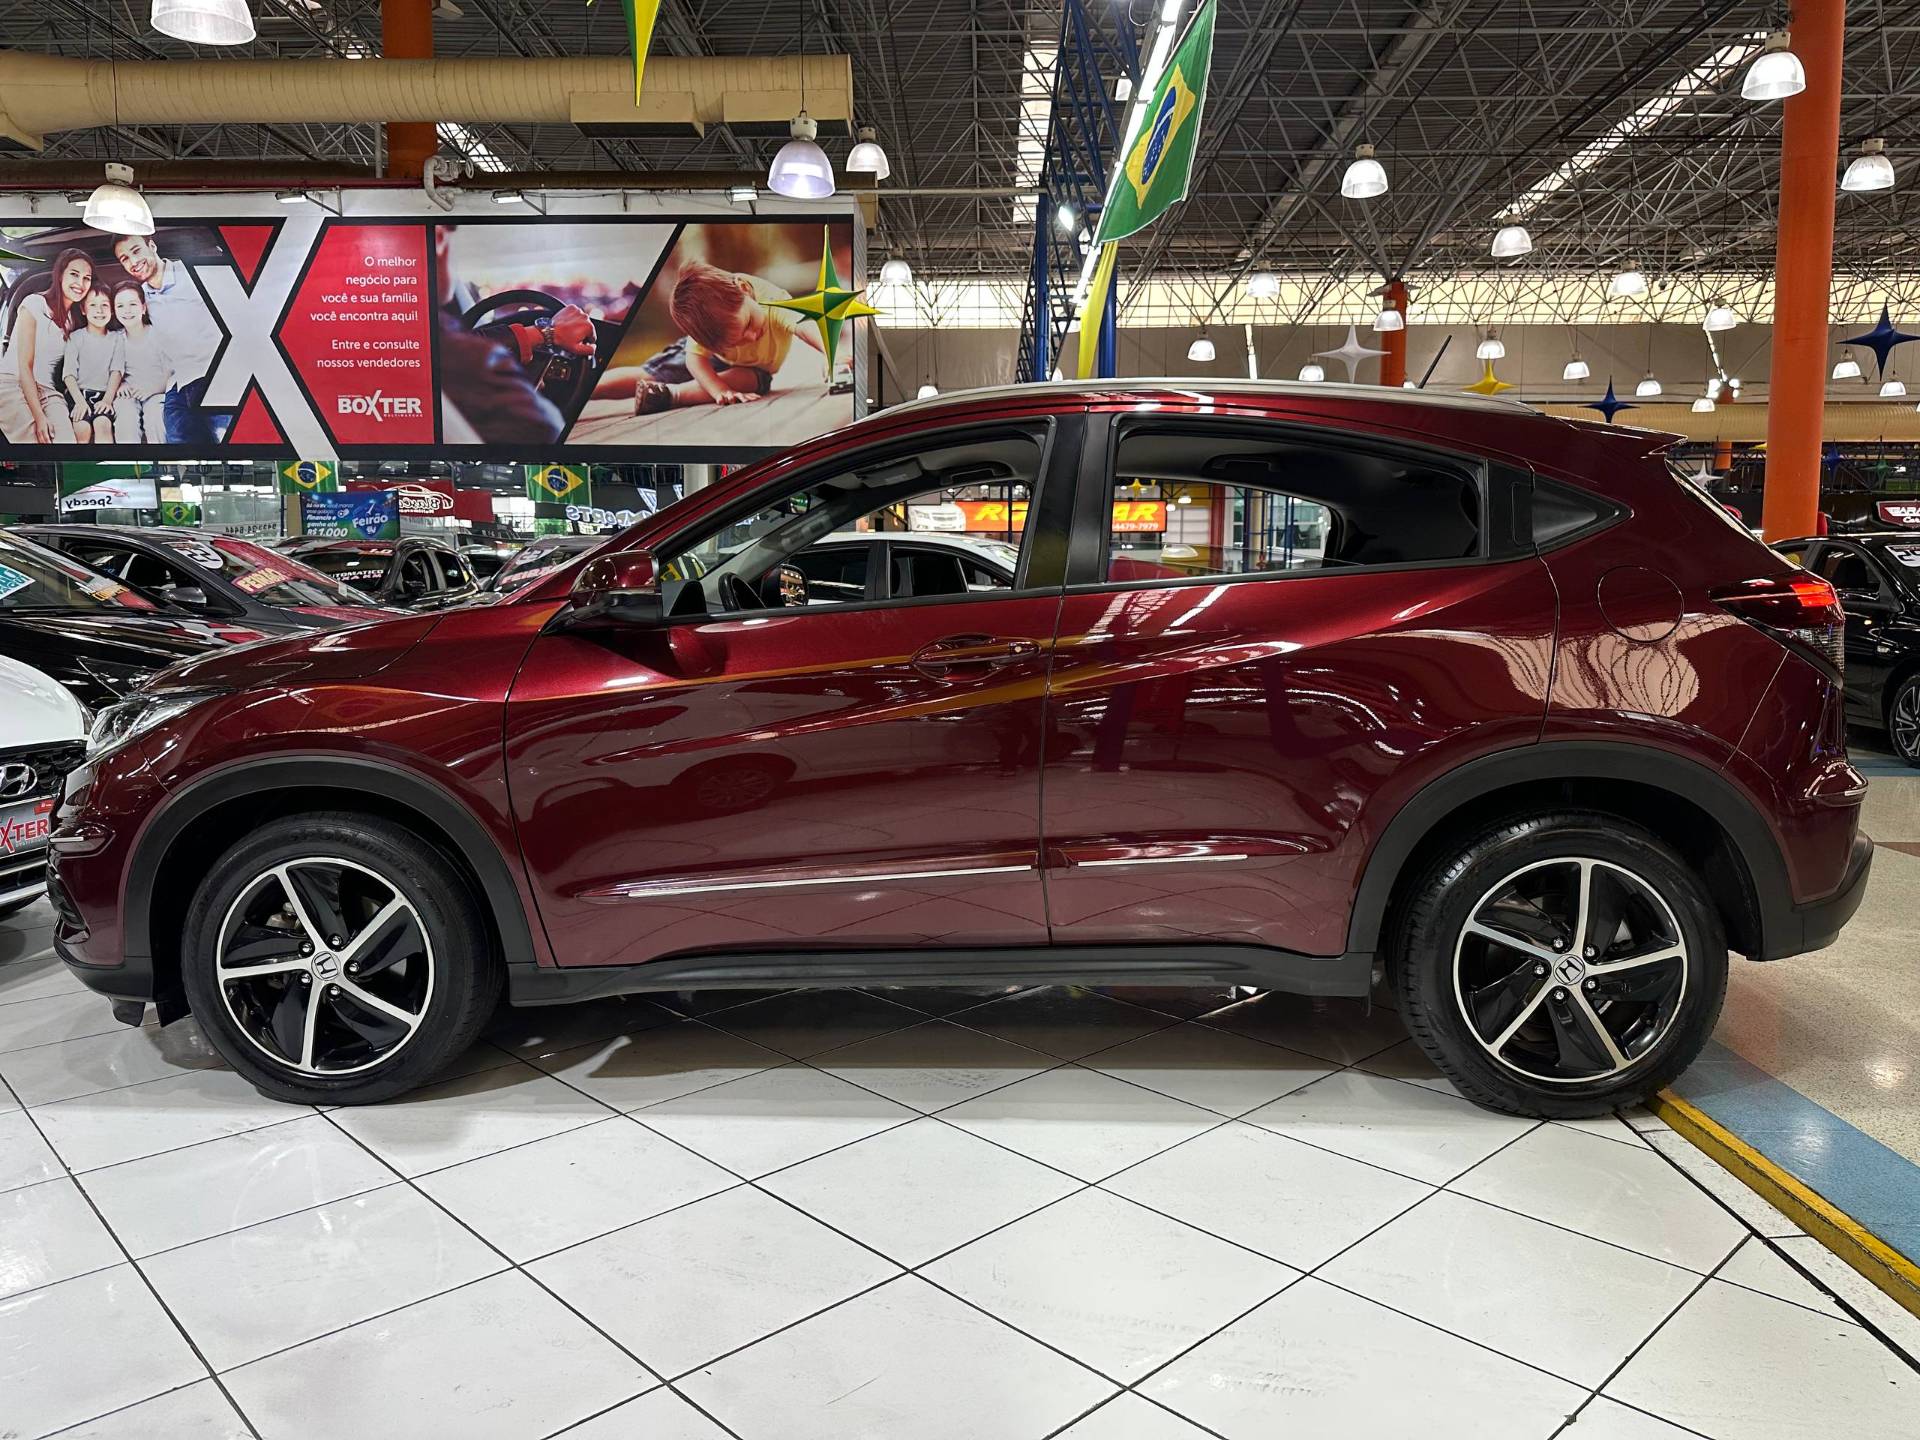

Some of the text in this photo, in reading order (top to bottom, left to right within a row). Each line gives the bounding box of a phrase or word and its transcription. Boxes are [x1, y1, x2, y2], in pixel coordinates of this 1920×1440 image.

[364, 256, 417, 267] O melhor
[345, 274, 417, 287] negócio para
[321, 292, 418, 303] você e sua família
[310, 310, 418, 323] você encontra aqui!
[331, 339, 420, 350] Entre e consulte
[317, 357, 421, 368] nossos vendedores
[337, 389, 422, 422] BOXTER
[352, 513, 389, 529] Feirão
[307, 527, 348, 537] R$ 1.000
